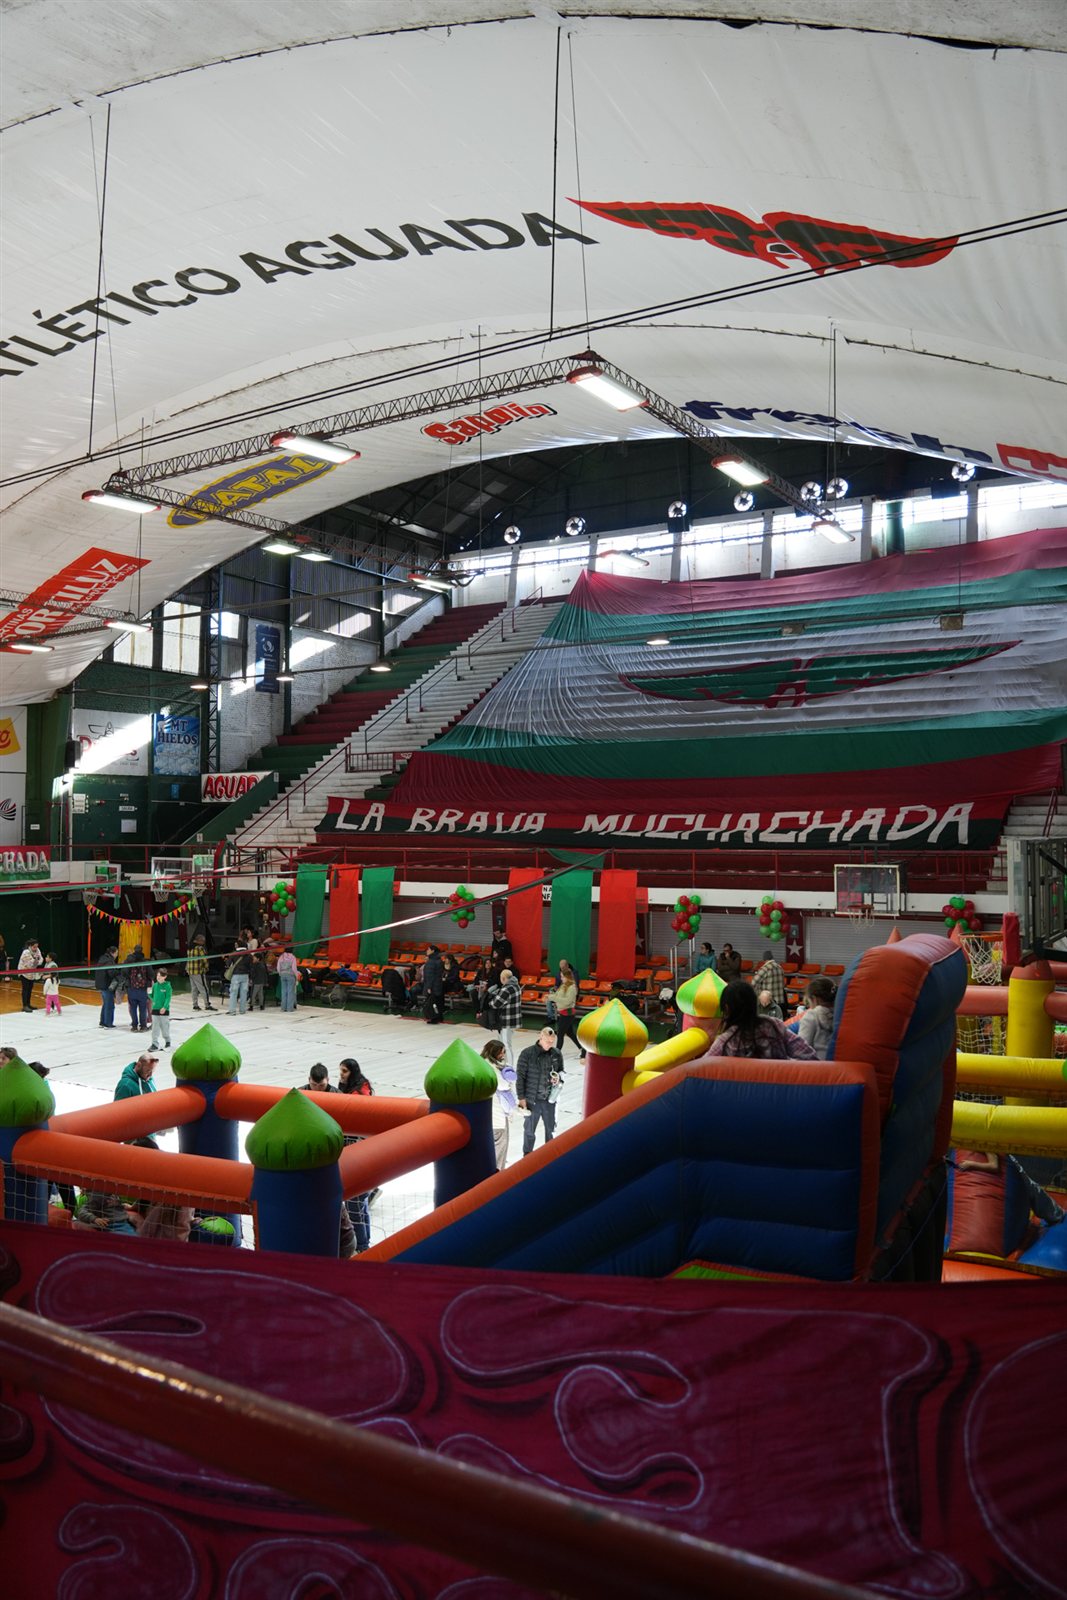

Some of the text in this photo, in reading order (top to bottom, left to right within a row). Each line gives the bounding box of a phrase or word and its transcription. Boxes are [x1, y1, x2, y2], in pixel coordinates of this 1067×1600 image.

[239, 212, 600, 284] AGUADA
[420, 401, 557, 445] Sapolin
[157, 734, 198, 745] HIELOS
[170, 719, 189, 732] MT
[335, 799, 386, 832] LA
[575, 802, 976, 845] MUCHACHADA
[0, 850, 49, 873] HADA
